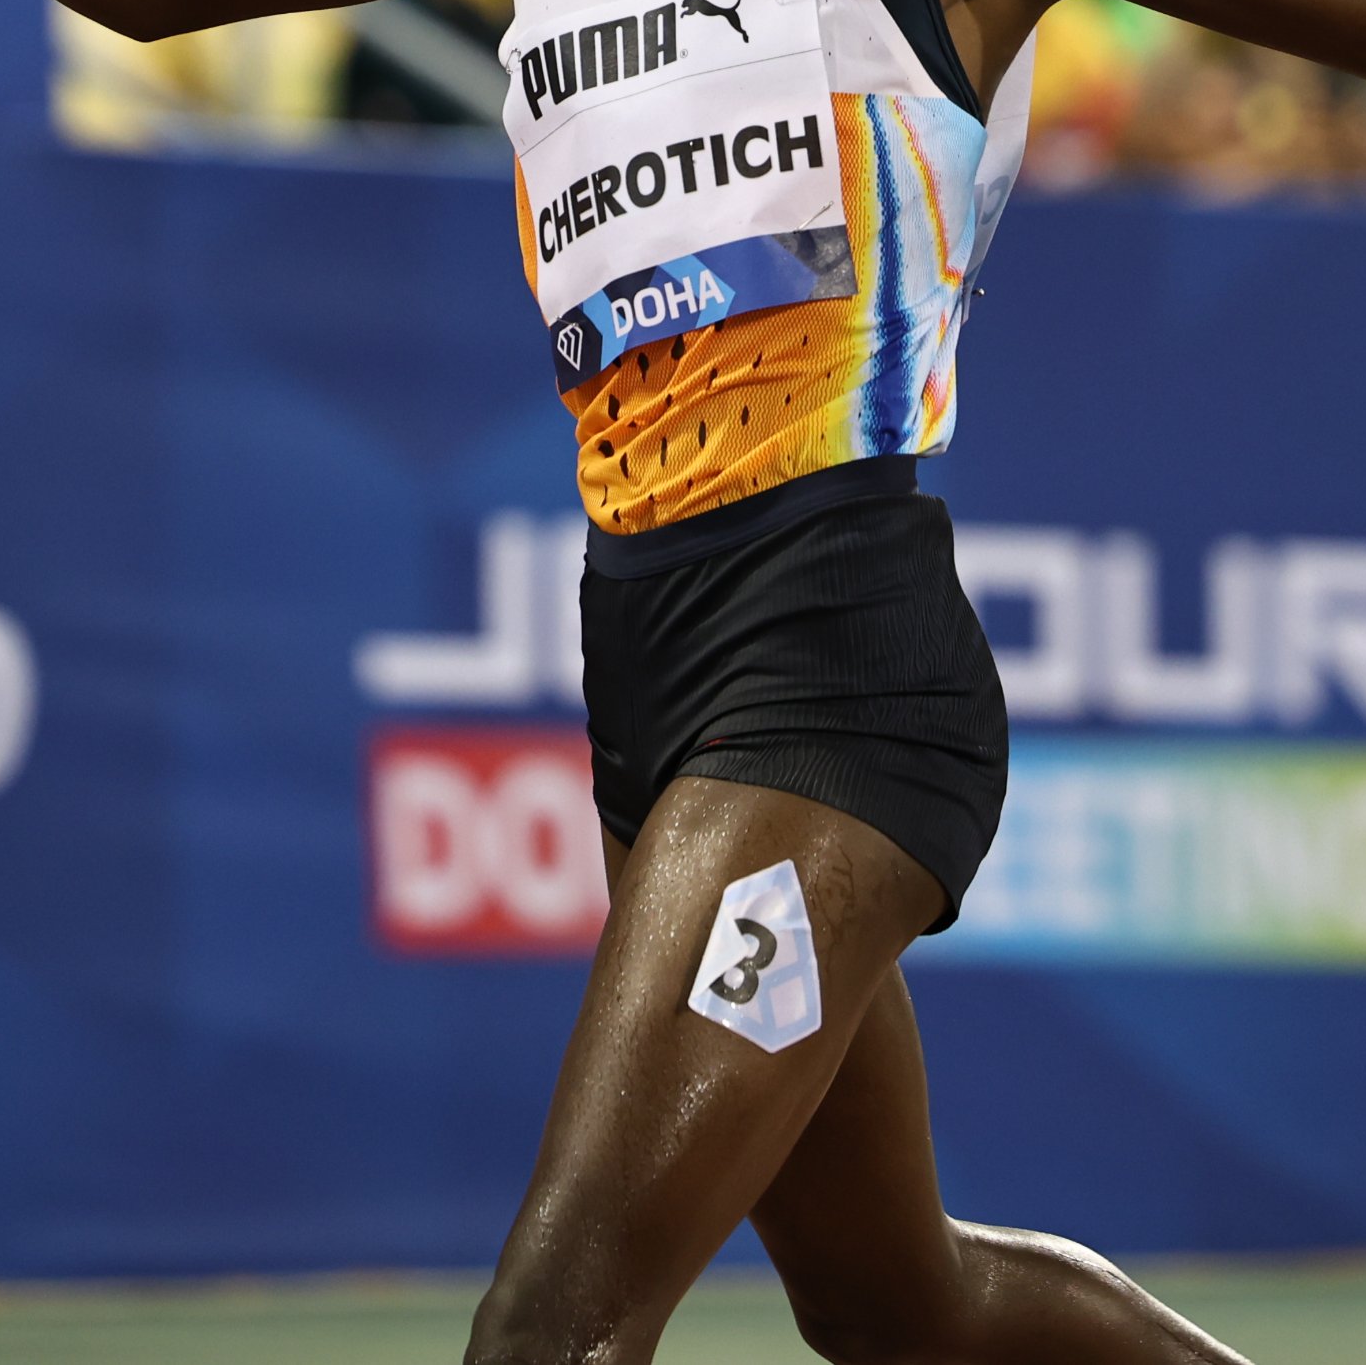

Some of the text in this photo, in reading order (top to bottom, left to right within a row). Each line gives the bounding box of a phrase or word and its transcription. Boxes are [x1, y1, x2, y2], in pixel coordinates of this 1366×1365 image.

[520, 2, 678, 121] PUMA
[538, 115, 824, 264] CHEROTICH
[609, 269, 725, 339] DOHA
[709, 918, 777, 1005] 3
